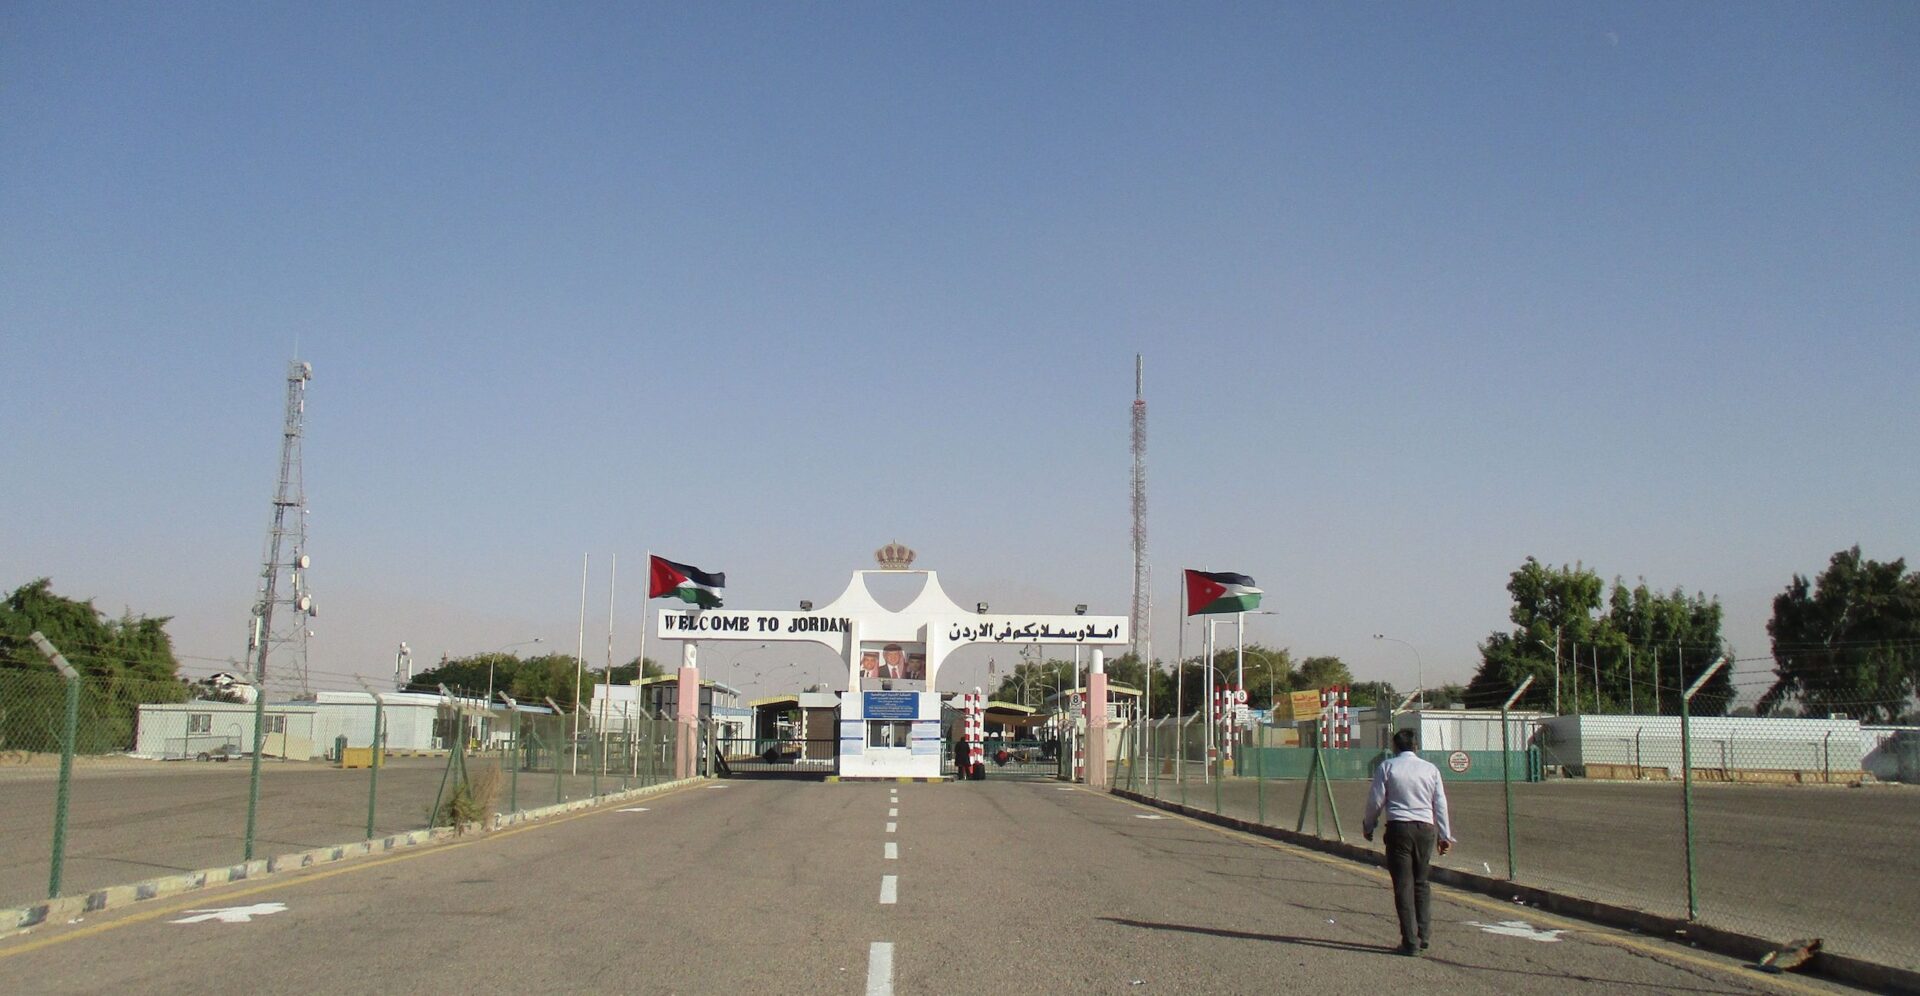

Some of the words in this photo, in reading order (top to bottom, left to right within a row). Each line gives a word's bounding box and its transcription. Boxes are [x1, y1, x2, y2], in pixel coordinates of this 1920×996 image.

[665, 615, 749, 632] WELCOME
[757, 616, 779, 632] TO
[788, 616, 850, 633] JORDAN
[949, 622, 993, 642] الاردن
[994, 621, 1012, 643] في
[1239, 692, 1245, 700] 8
